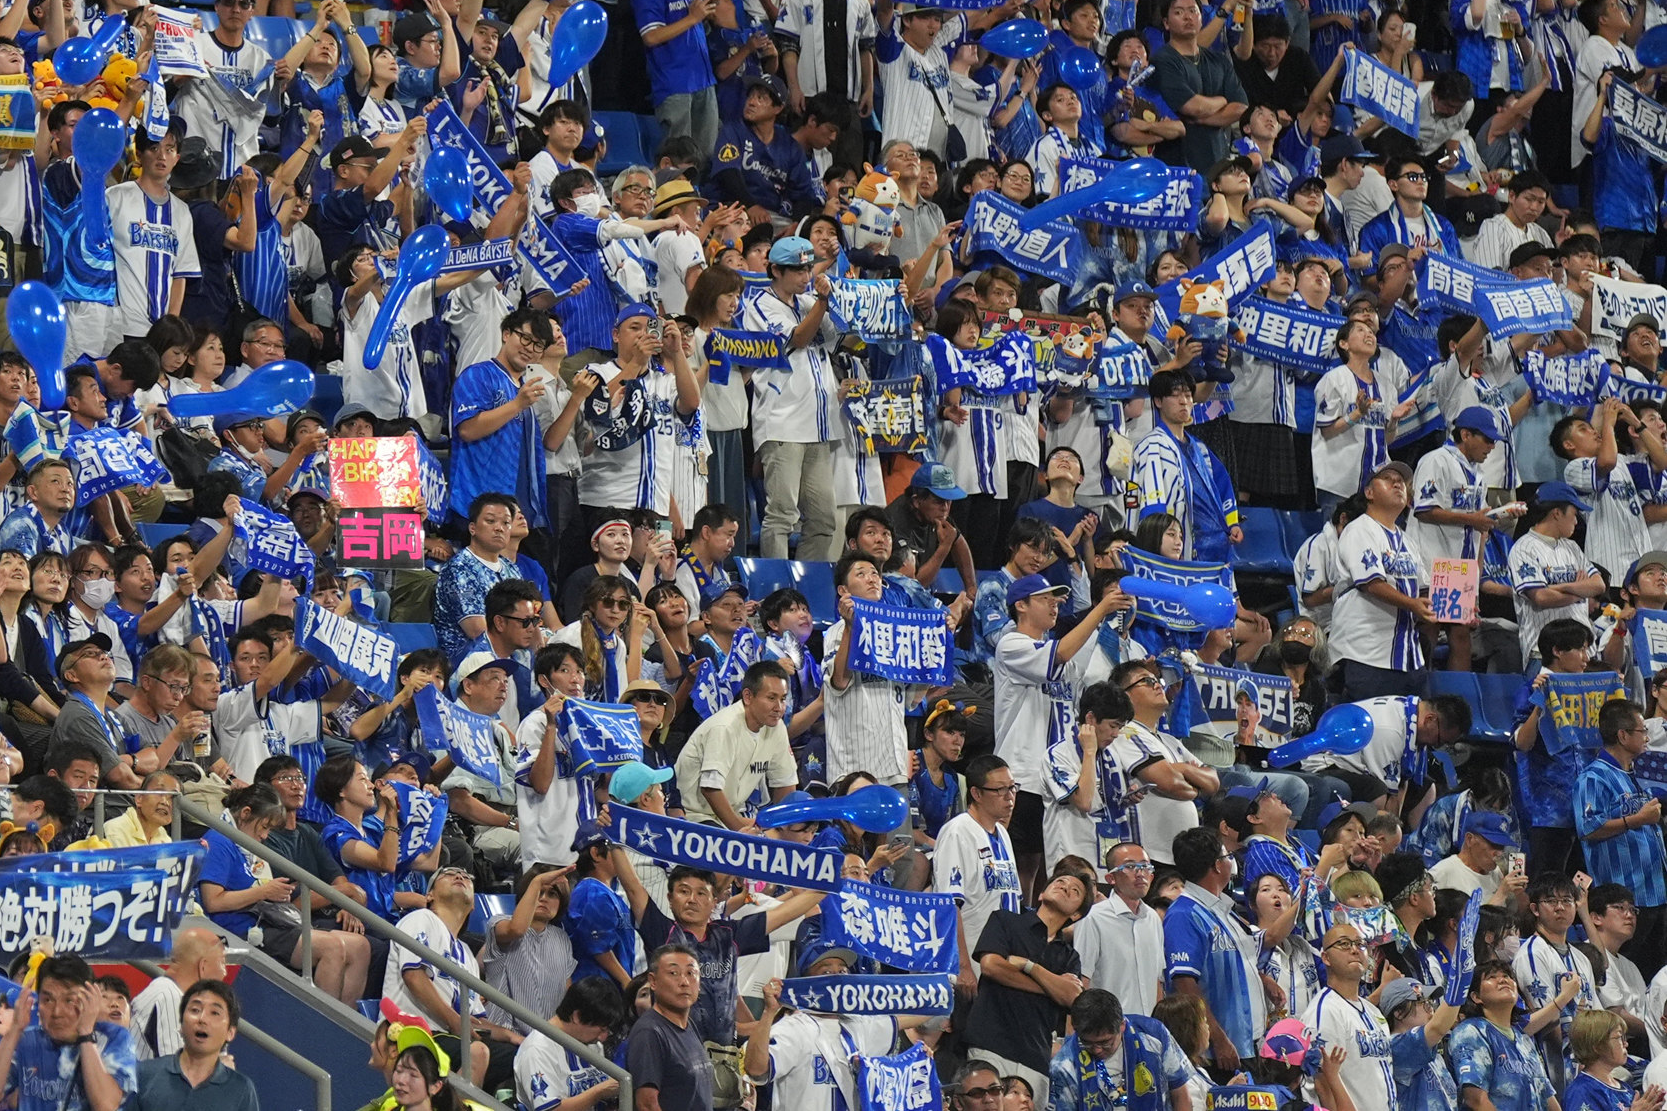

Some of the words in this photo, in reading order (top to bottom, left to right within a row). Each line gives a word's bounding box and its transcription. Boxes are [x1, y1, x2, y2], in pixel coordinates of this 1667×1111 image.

[456, 248, 479, 265] DeNA
[1217, 235, 1275, 301] 琢真
[657, 417, 674, 437] 25
[340, 513, 423, 561] 吉岡
[1194, 674, 1294, 730] TASEI
[619, 818, 627, 843] I
[667, 829, 836, 884] YOKOHAMA
[839, 891, 945, 958] 森唯斗
[826, 982, 949, 1012] YOKOHAMA
[1214, 1093, 1245, 1109] Asahi
